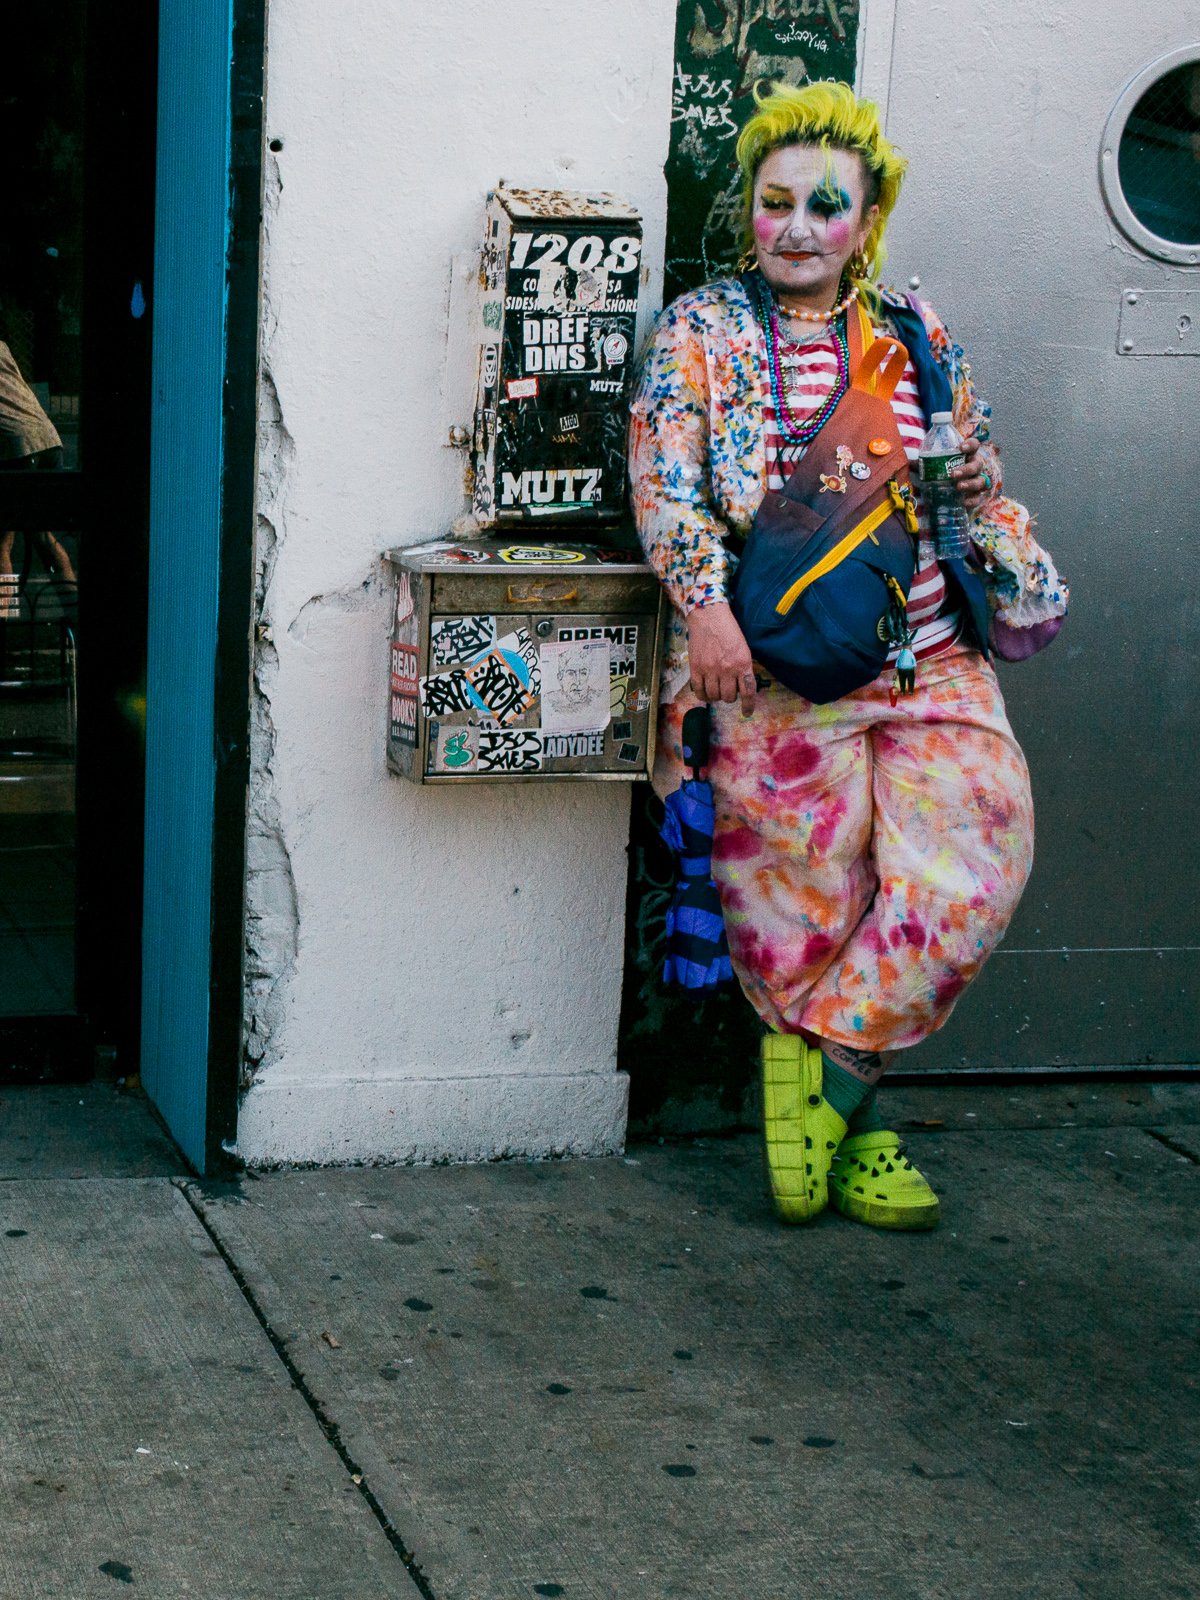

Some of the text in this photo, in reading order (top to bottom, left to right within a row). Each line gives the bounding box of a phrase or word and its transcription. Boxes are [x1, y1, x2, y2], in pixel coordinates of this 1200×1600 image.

[510, 232, 642, 274] 1208
[524, 318, 590, 346] DREF
[526, 343, 586, 373] DMS
[590, 380, 624, 392] MUTZ
[501, 468, 602, 505] MUTZ
[392, 648, 417, 681] READ
[542, 735, 604, 758] LADYDEE
